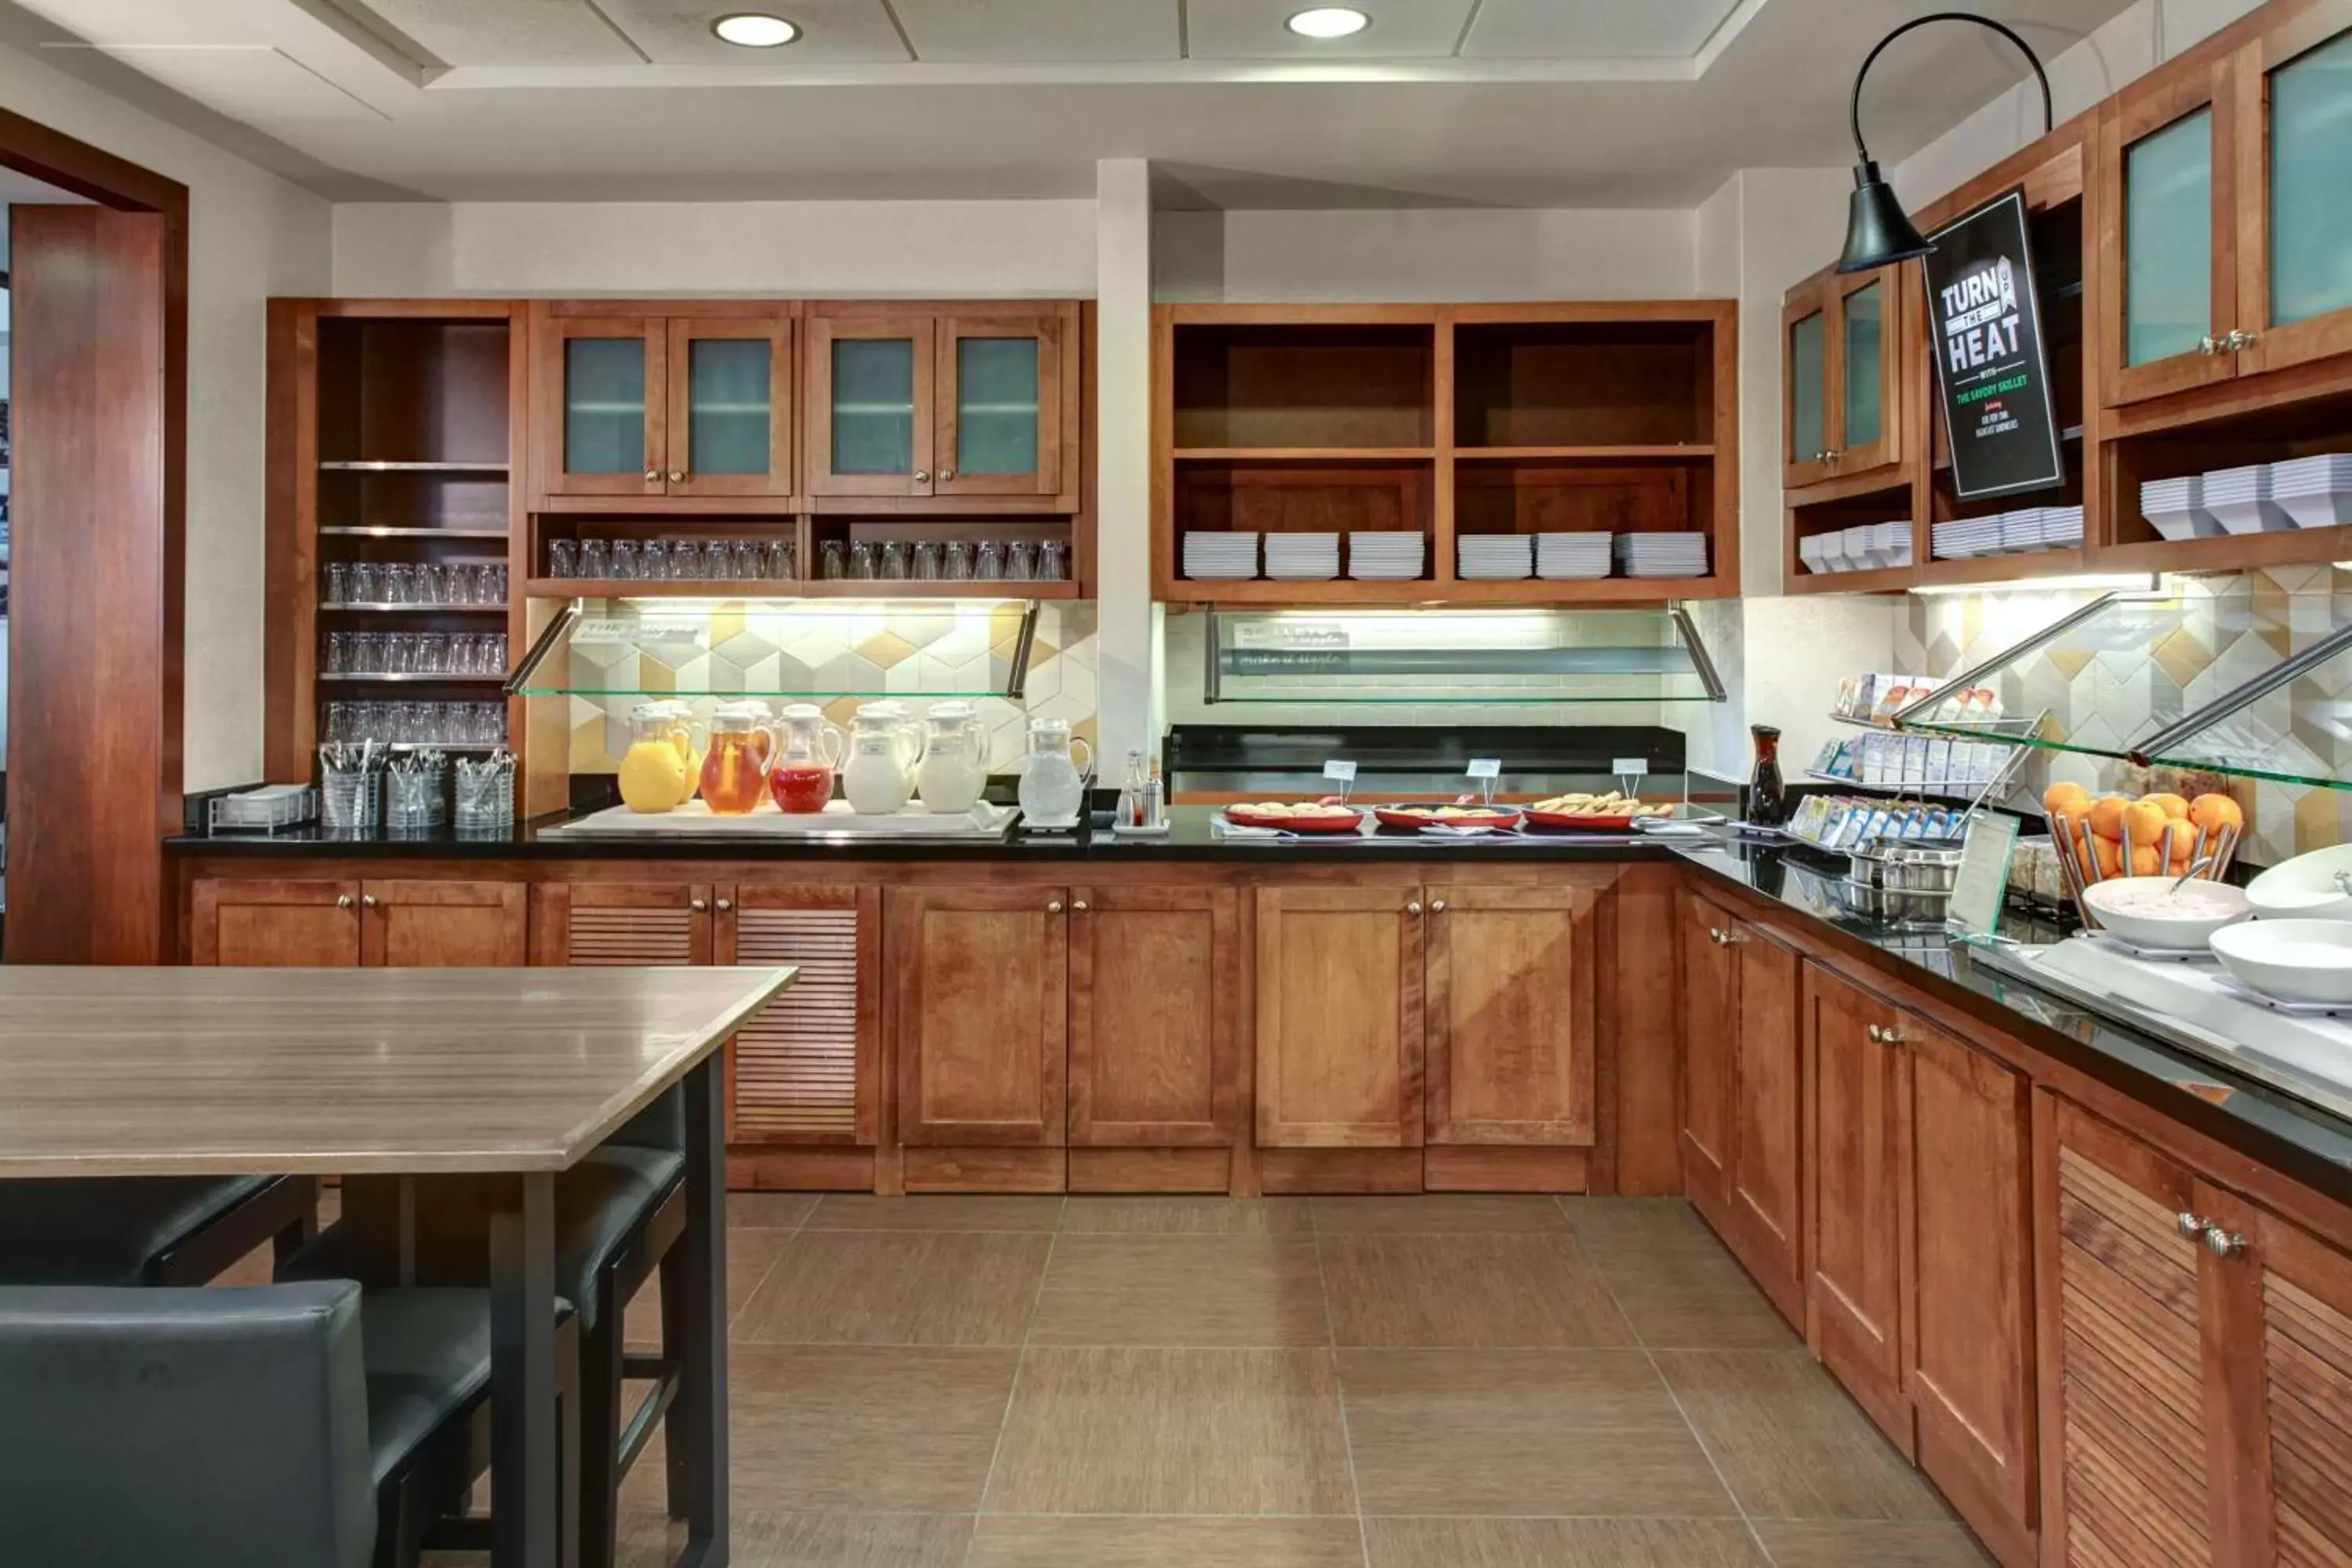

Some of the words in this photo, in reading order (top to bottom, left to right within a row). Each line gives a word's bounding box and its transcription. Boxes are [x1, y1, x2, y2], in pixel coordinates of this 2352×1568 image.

[1941, 267, 1998, 317] TURN
[1963, 310, 1983, 326] THE
[1947, 314, 2020, 373] HEAT
[1957, 393, 1970, 405] THE
[1971, 383, 1997, 400] SAVORY
[1998, 375, 2027, 392] SKILLET
